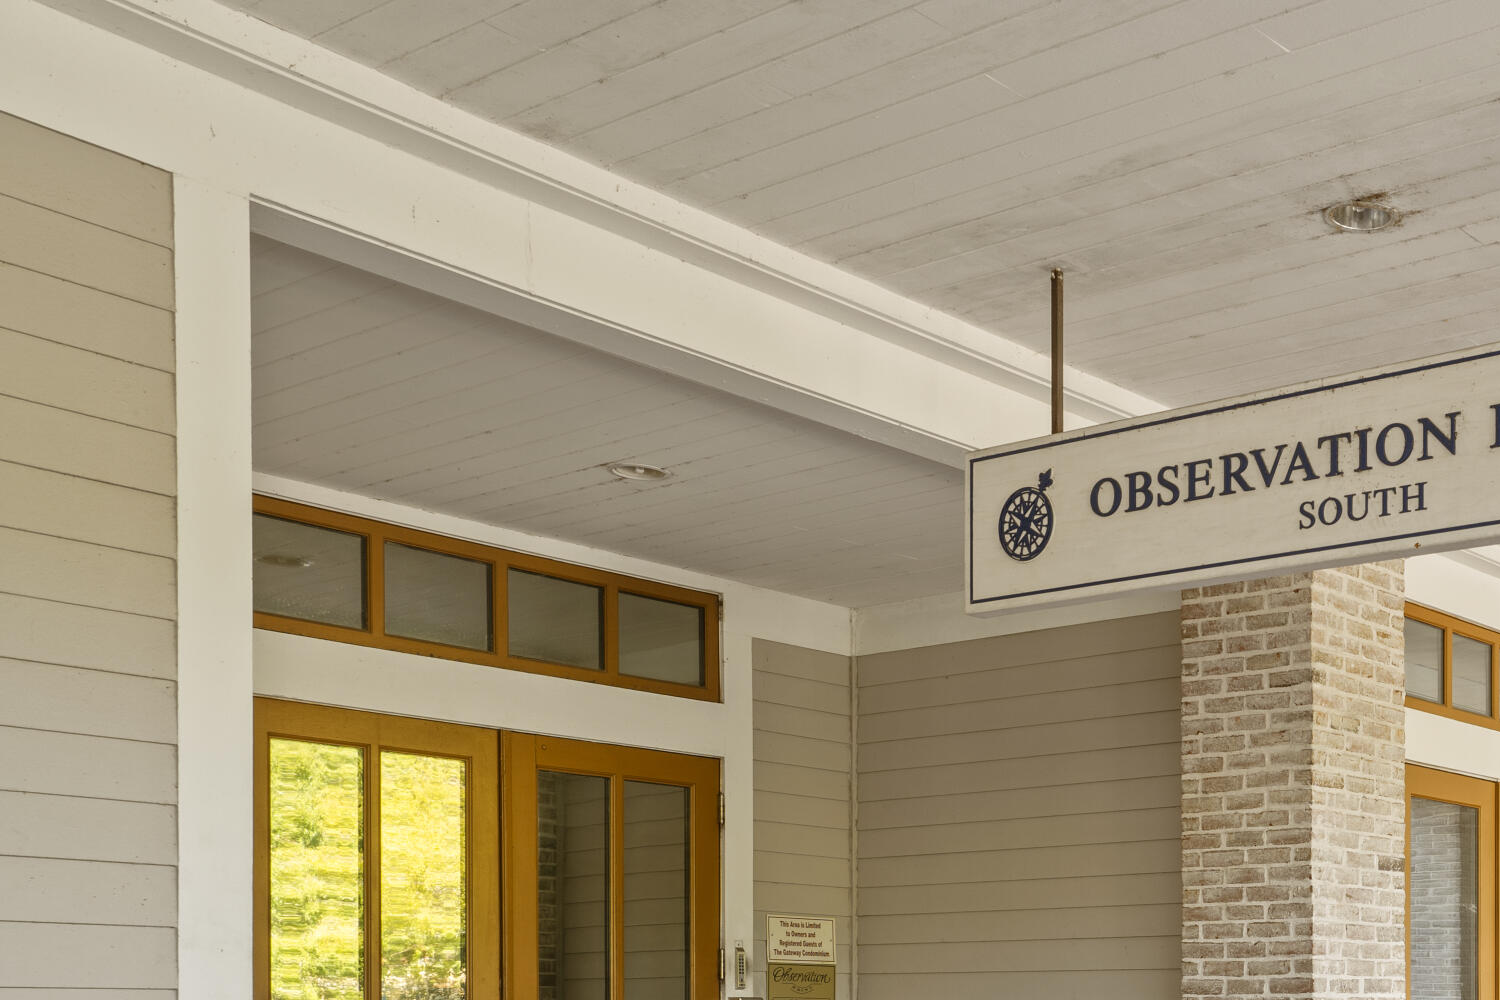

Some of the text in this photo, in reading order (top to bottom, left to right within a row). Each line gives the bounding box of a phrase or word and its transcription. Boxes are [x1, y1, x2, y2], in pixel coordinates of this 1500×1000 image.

[1089, 411, 1462, 518] OBSERVATION
[1298, 481, 1429, 530] SOUTH
[779, 920, 789, 928] This
[791, 930, 807, 938] Owners
[779, 939, 823, 948] Registered Guests of
[773, 948, 782, 956] The
[783, 949, 801, 958] Gateway
[772, 966, 831, 984] Observation
